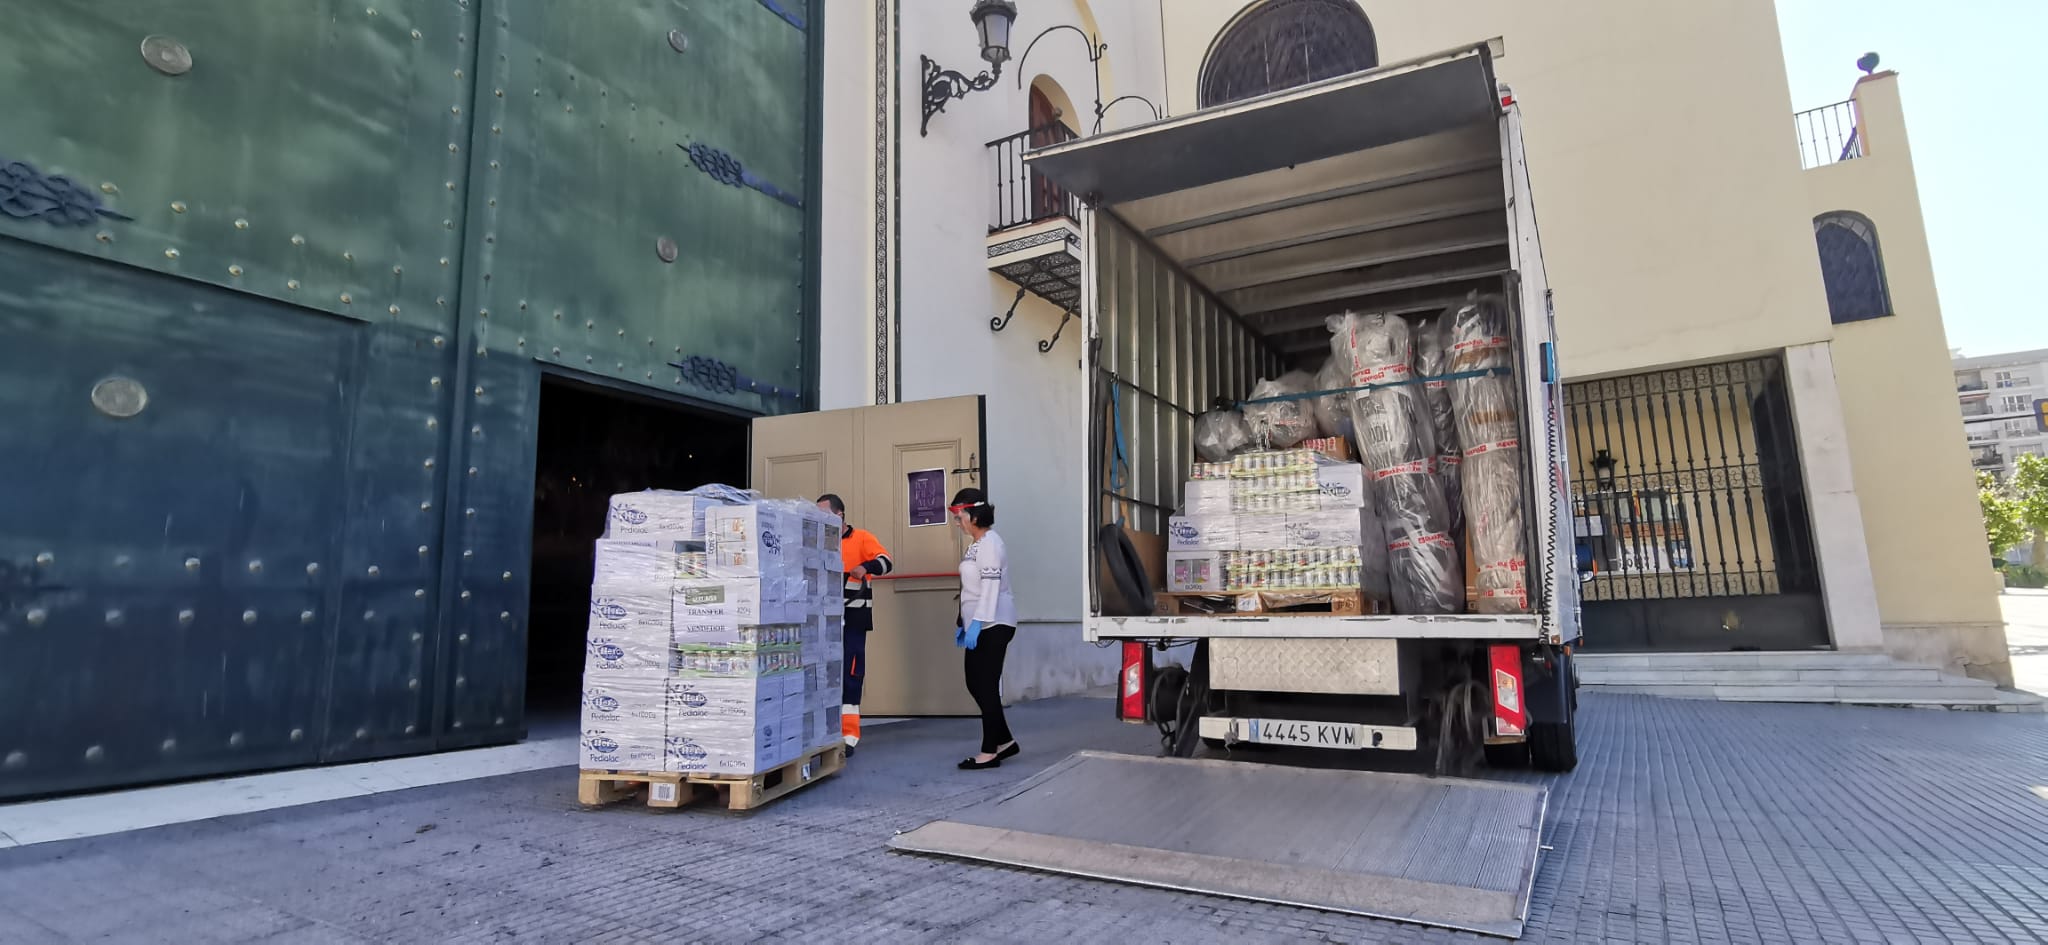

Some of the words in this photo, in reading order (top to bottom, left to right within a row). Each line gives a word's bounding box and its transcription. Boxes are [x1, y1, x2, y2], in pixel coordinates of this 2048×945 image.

[688, 608, 724, 616] TRANSFER
[1263, 722, 1310, 742] 4445
[1318, 725, 1356, 745] KVM
[590, 753, 619, 762] Pedialac
